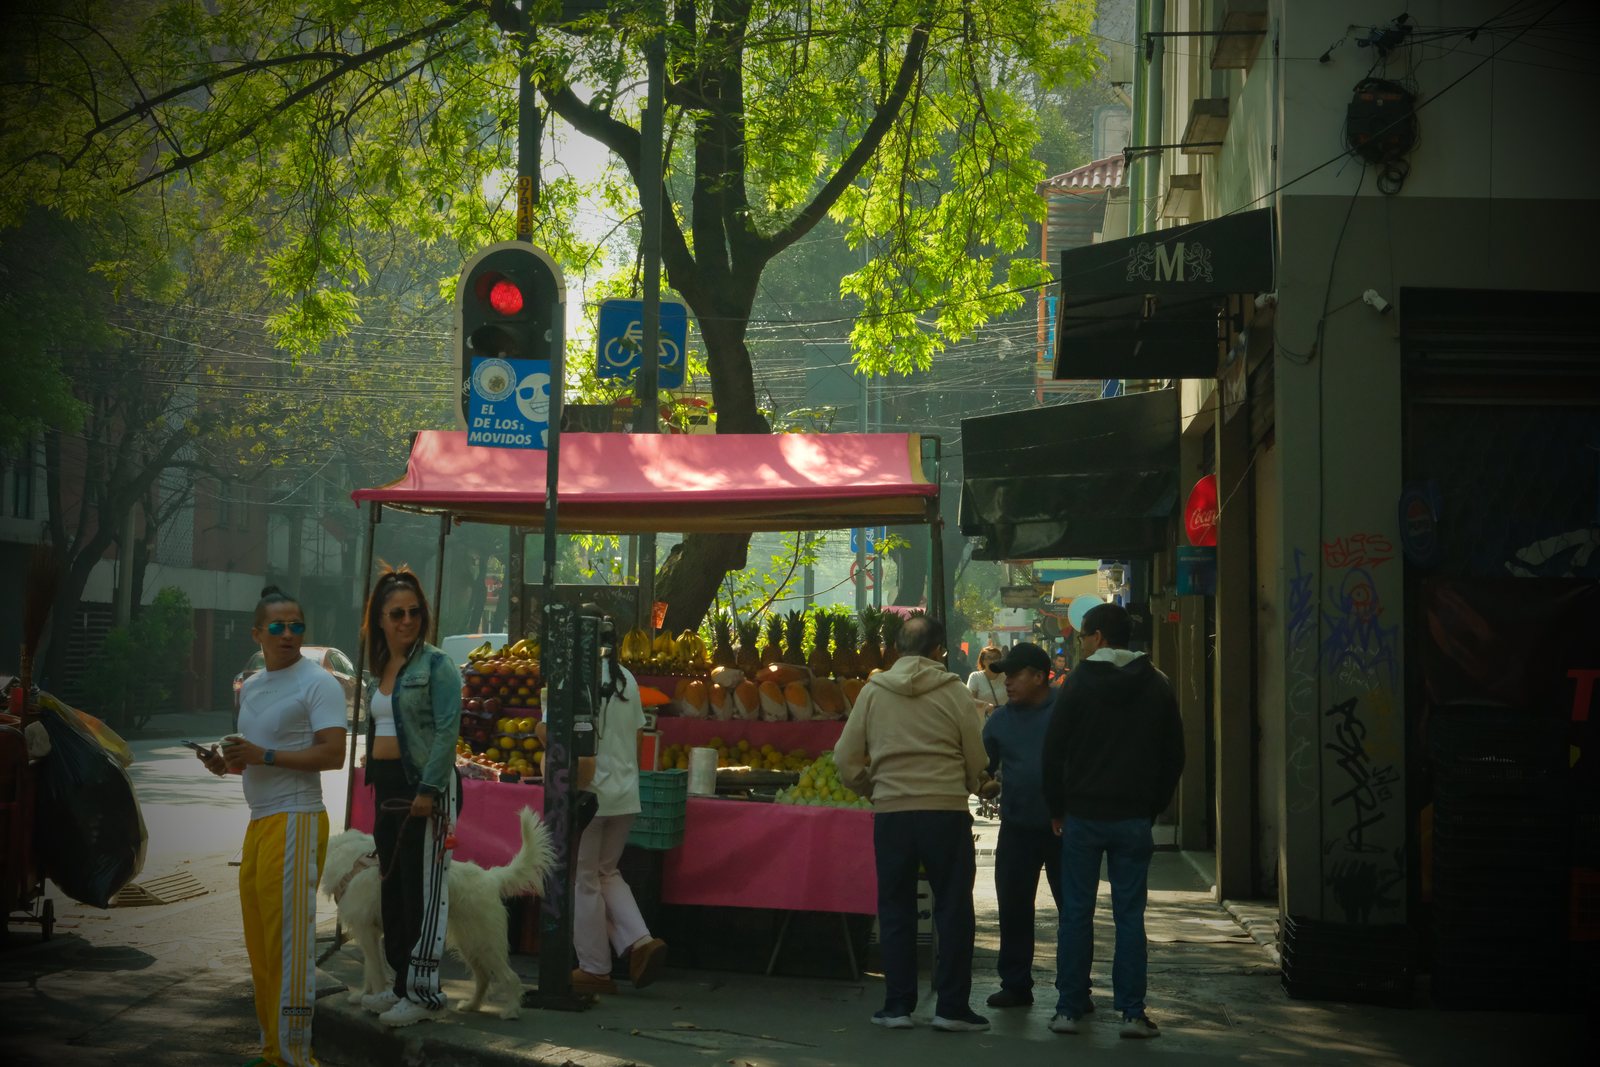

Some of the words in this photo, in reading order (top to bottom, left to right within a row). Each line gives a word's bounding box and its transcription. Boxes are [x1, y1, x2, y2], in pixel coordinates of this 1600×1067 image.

[1154, 241, 1185, 282] M
[481, 404, 496, 415] EL
[473, 417, 492, 429] DE
[494, 418, 519, 431] LOS
[469, 431, 532, 445] MOVIDOS
[410, 958, 439, 969] adidas
[282, 1006, 313, 1017] adidas
